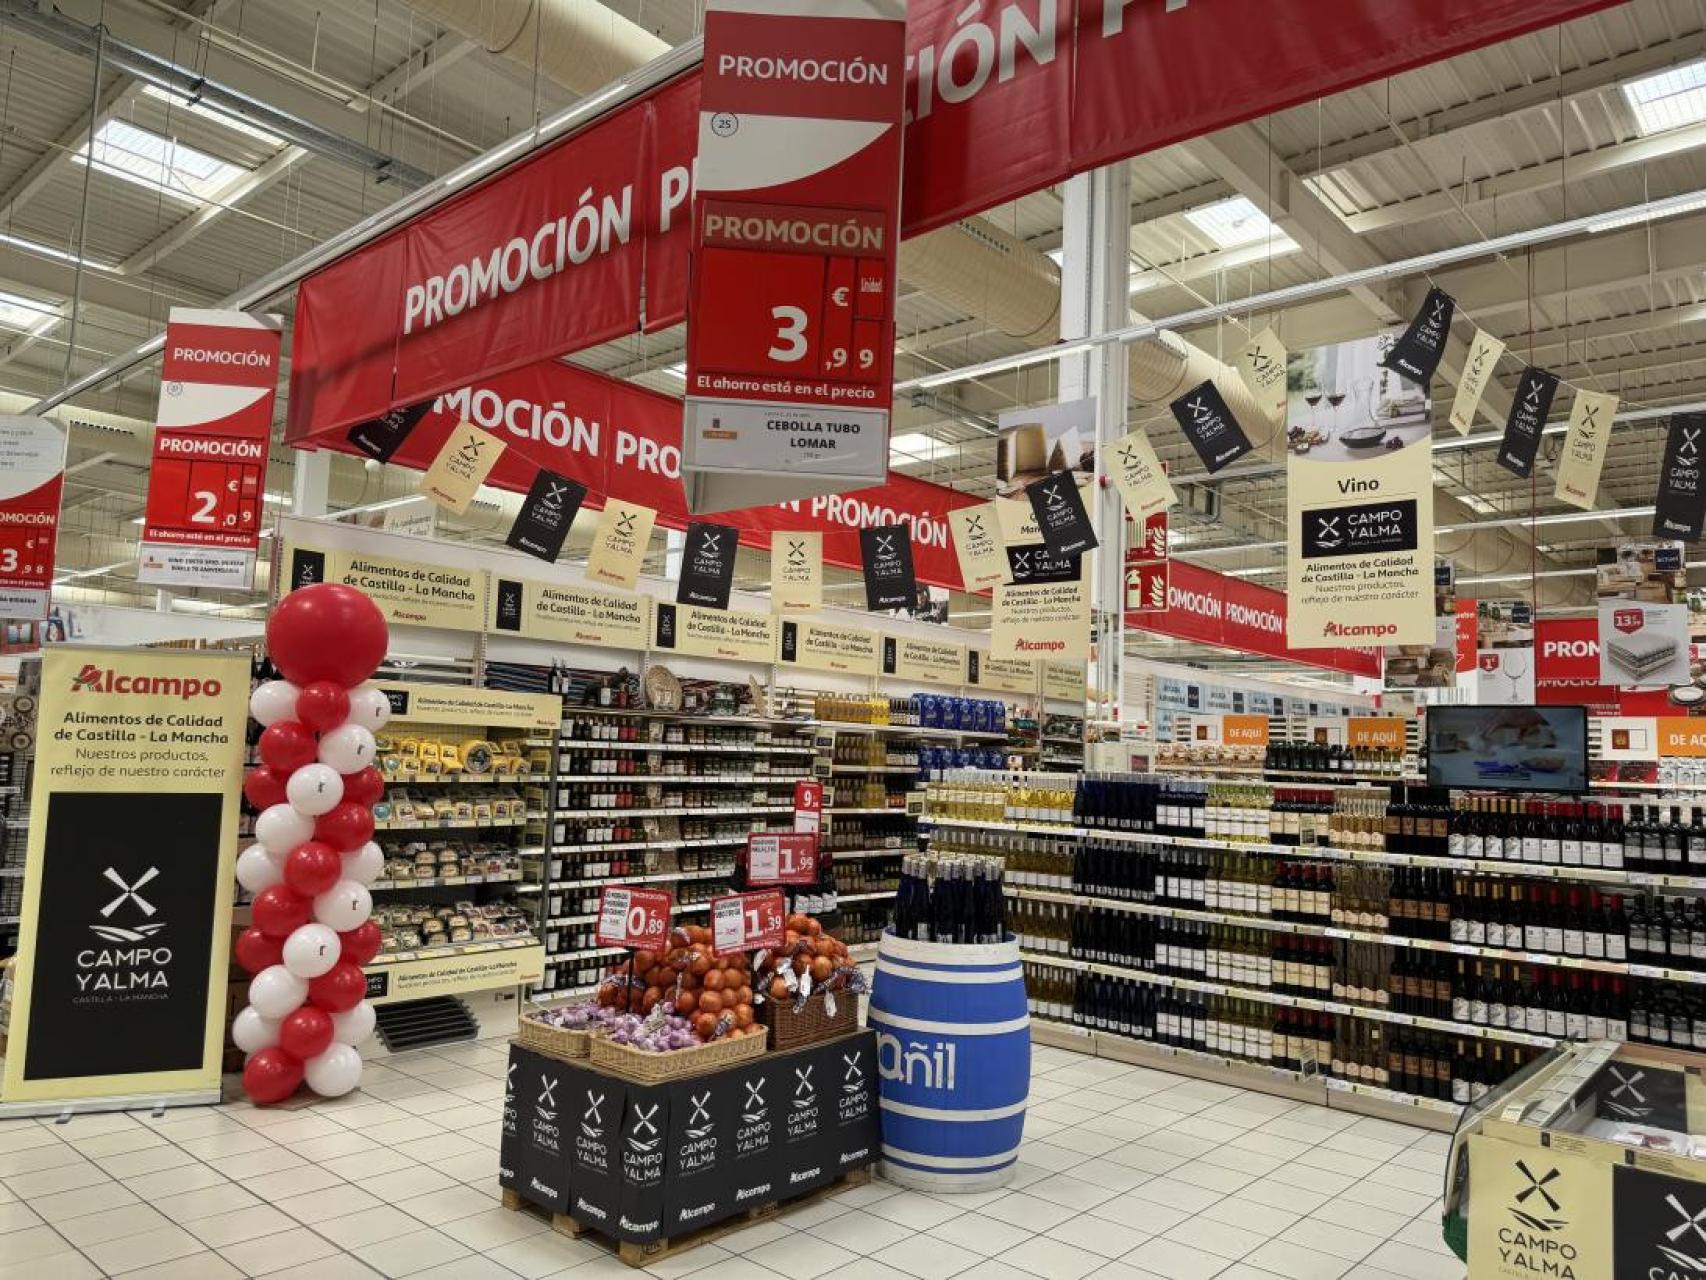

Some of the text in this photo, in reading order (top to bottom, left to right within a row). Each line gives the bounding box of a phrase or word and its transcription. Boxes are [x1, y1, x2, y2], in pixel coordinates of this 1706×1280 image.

[718, 54, 888, 85] PROMOCIÓN
[718, 119, 731, 129] 25
[705, 214, 883, 250] PROMOCIÓN
[404, 184, 633, 335] PROMOCIÓN
[832, 287, 849, 307] €
[173, 347, 271, 368] PROMOCIÓN
[697, 376, 875, 399] El ahorro está en el precio
[767, 420, 860, 434] CEBOLLA TUBO
[160, 438, 262, 458] PROMOCIÓN
[790, 438, 836, 449] LOMAR
[1669, 467, 1699, 479] CAMPO
[1337, 477, 1380, 494] Vino
[1669, 478, 1697, 490] YALMA
[1348, 509, 1402, 526] CAMPO
[1348, 524, 1401, 539] YALMA
[1035, 559, 1072, 571] YALMA
[1306, 556, 1413, 573] Alimentos de Calidad
[350, 560, 471, 588] Alimentos de Calidad
[1301, 567, 1419, 583] de Castilla La Mancha
[343, 574, 475, 601] de Castilla La Mancha
[1315, 583, 1355, 594] Nuestros
[542, 589, 638, 611] Alimentos de Calidad
[537, 601, 548, 611] de
[550, 603, 586, 616] Castilla
[593, 609, 605, 618] La
[606, 611, 641, 624] Mancha
[1225, 601, 1282, 634] PROMOCIÓN
[1323, 621, 1398, 638] Alcampo
[1015, 638, 1065, 652] Alcampo
[70, 664, 222, 700] Alcampo
[63, 711, 223, 728] Alimentos de Calidad
[54, 728, 229, 744] de Castilla La Mancha
[1229, 728, 1241, 737] DE
[1357, 731, 1370, 743] DE
[1669, 734, 1686, 746] DE
[75, 748, 136, 760] Nuestros
[50, 765, 94, 779] reflejo
[99, 766, 114, 777] de
[119, 767, 169, 777] nuestro
[77, 947, 172, 967] CAMPO
[75, 971, 168, 991] YALMA
[839, 1091, 869, 1108] CAMPO
[788, 1107, 819, 1125] CAMPO
[839, 1103, 868, 1120] YALMA
[533, 1119, 559, 1138] CAMPO
[736, 1121, 772, 1140] CAMPO
[787, 1119, 817, 1136] YALMA
[533, 1131, 559, 1150] YALMA
[576, 1136, 607, 1156] CAMPO
[680, 1137, 717, 1156] CAMPO
[736, 1134, 769, 1153] YALMA
[577, 1149, 608, 1168] YALMA
[624, 1151, 663, 1167] CAMPO
[679, 1151, 716, 1169] YALMA
[624, 1164, 661, 1181] YALMA
[1498, 1228, 1577, 1261] CAMPO
[1498, 1247, 1576, 1280] YALMA
